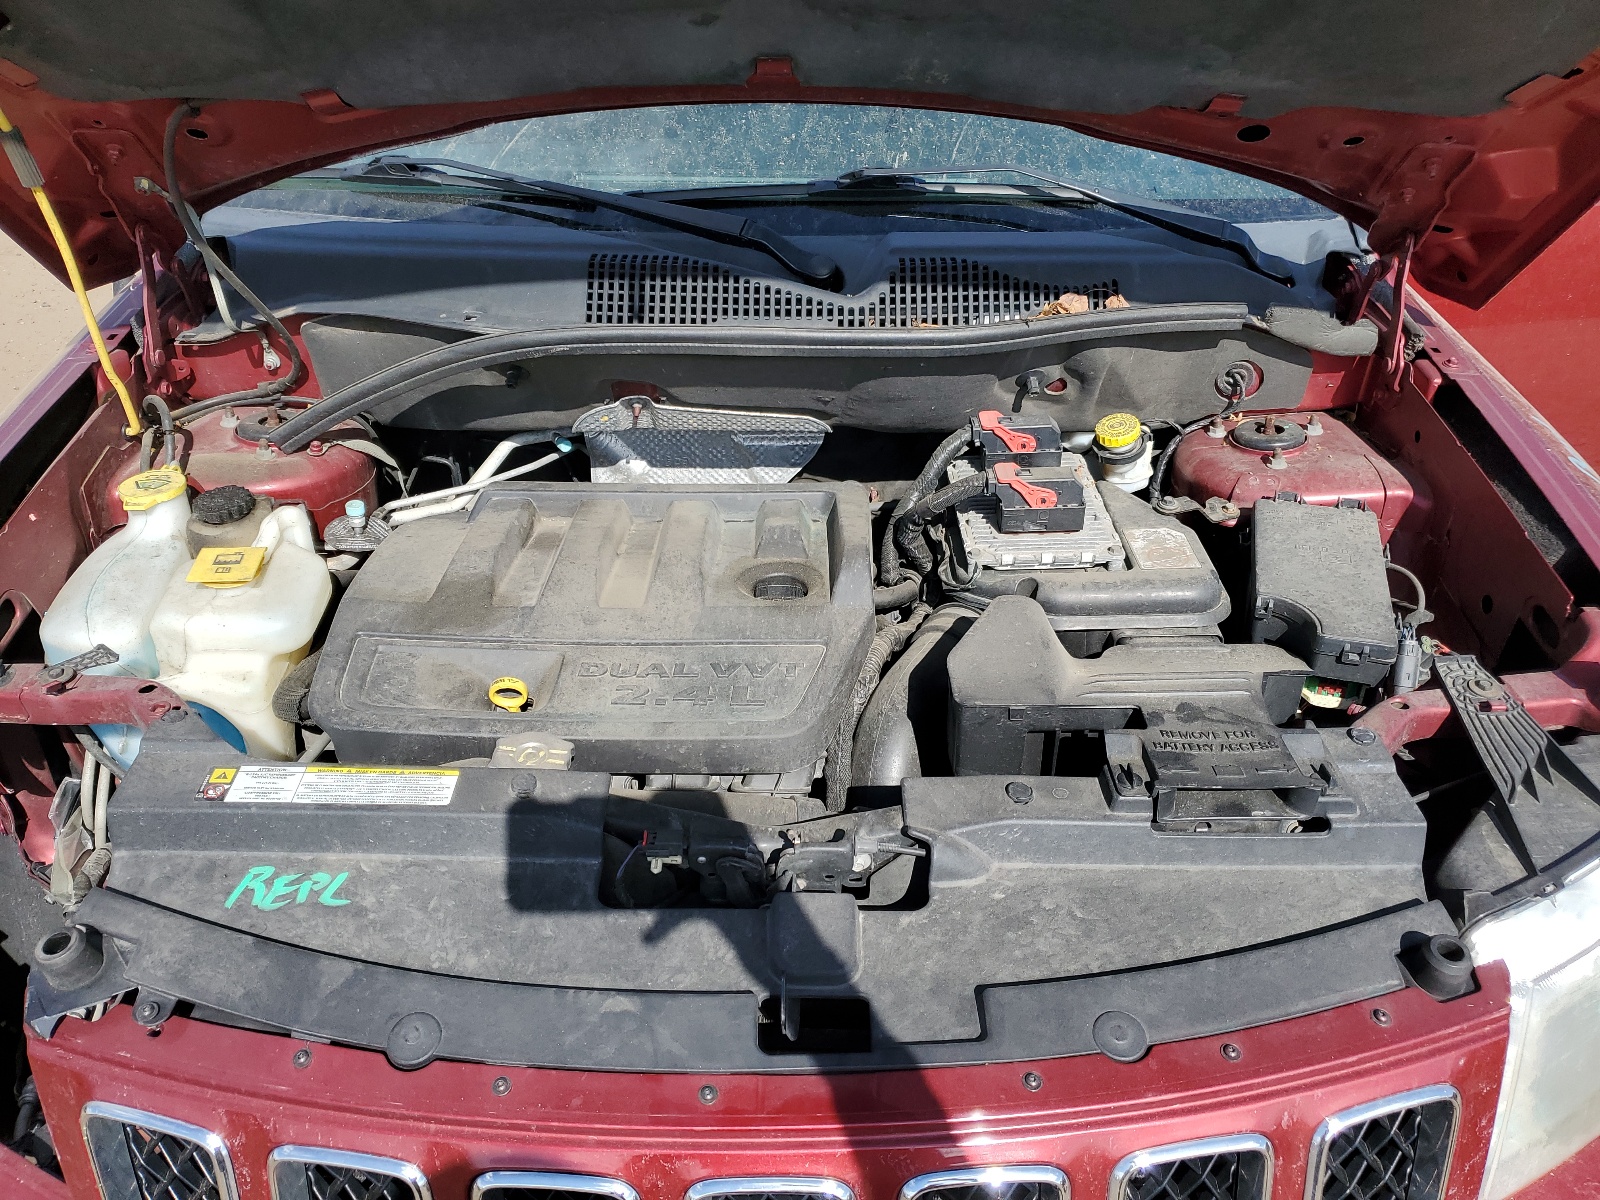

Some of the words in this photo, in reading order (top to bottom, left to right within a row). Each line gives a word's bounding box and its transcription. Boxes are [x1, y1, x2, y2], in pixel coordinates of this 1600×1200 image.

[577, 662, 700, 679] DUAL
[709, 662, 806, 679] VVT
[610, 684, 767, 707] 2.4L
[1159, 729, 1222, 740] REMOVE
[1224, 730, 1257, 739] FOR
[1152, 741, 1214, 752] BATTERY
[1220, 740, 1280, 752] ACCESS
[224, 865, 352, 911] REPL
